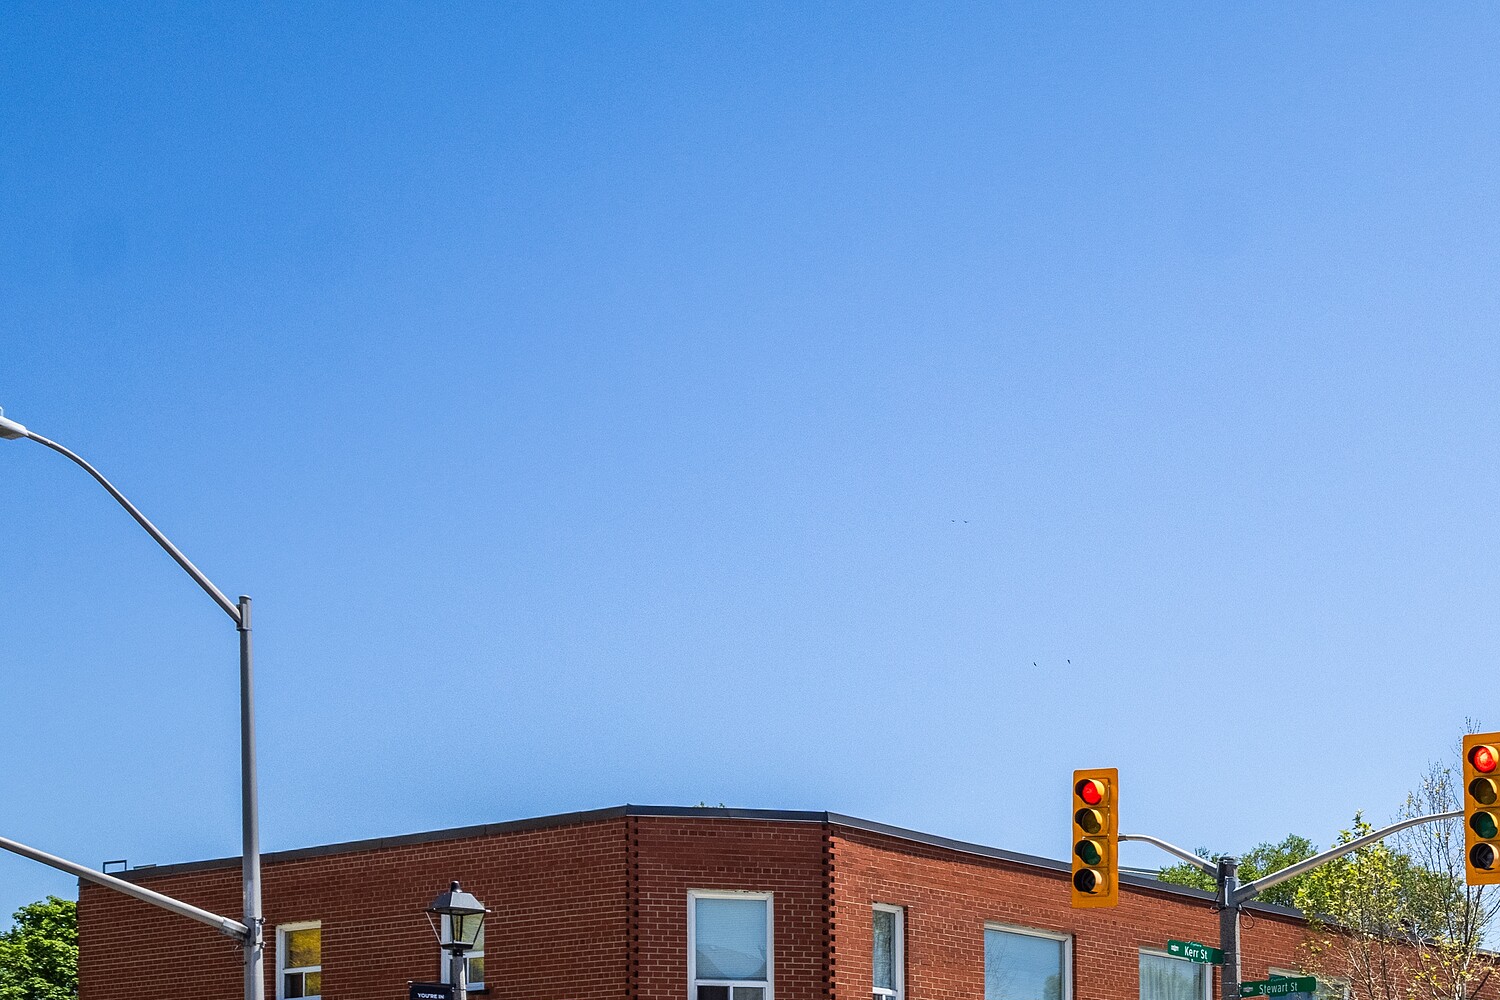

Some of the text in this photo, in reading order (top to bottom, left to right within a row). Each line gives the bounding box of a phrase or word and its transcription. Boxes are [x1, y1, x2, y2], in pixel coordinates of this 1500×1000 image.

[1184, 945, 1200, 958] Kerr
[1200, 949, 1208, 960] St
[1258, 983, 1289, 995] Stewart
[1290, 982, 1298, 992] St
[417, 992, 438, 1000] YOU'RE
